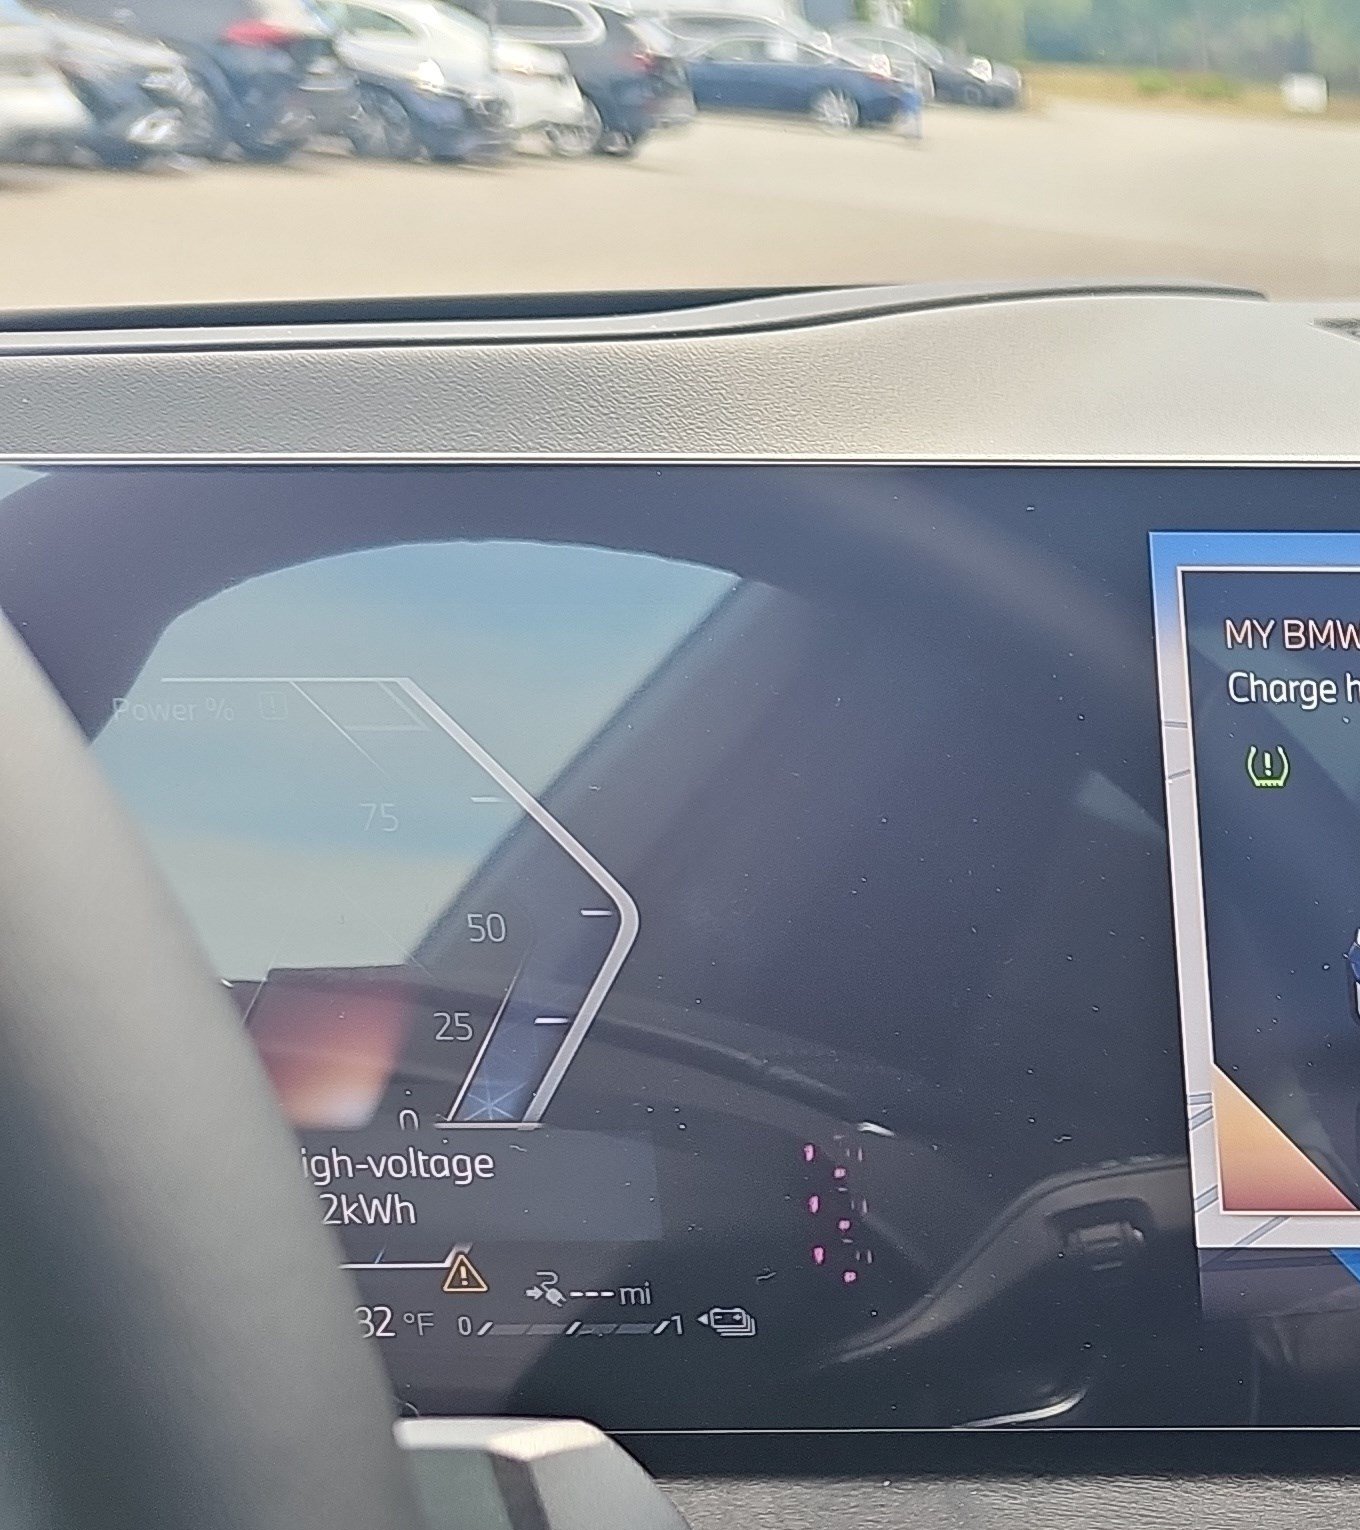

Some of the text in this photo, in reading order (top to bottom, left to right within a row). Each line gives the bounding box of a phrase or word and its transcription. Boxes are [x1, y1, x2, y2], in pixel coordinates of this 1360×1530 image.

[1225, 619, 1277, 650] MY
[1228, 671, 1337, 710] Charge
[112, 697, 198, 722] Power
[359, 802, 399, 832] 75
[467, 913, 506, 942] 50
[433, 1012, 474, 1041] 25
[301, 1147, 496, 1186] igh-voltage
[319, 1193, 417, 1226] 2kWh
[457, 1316, 472, 1336] 0
